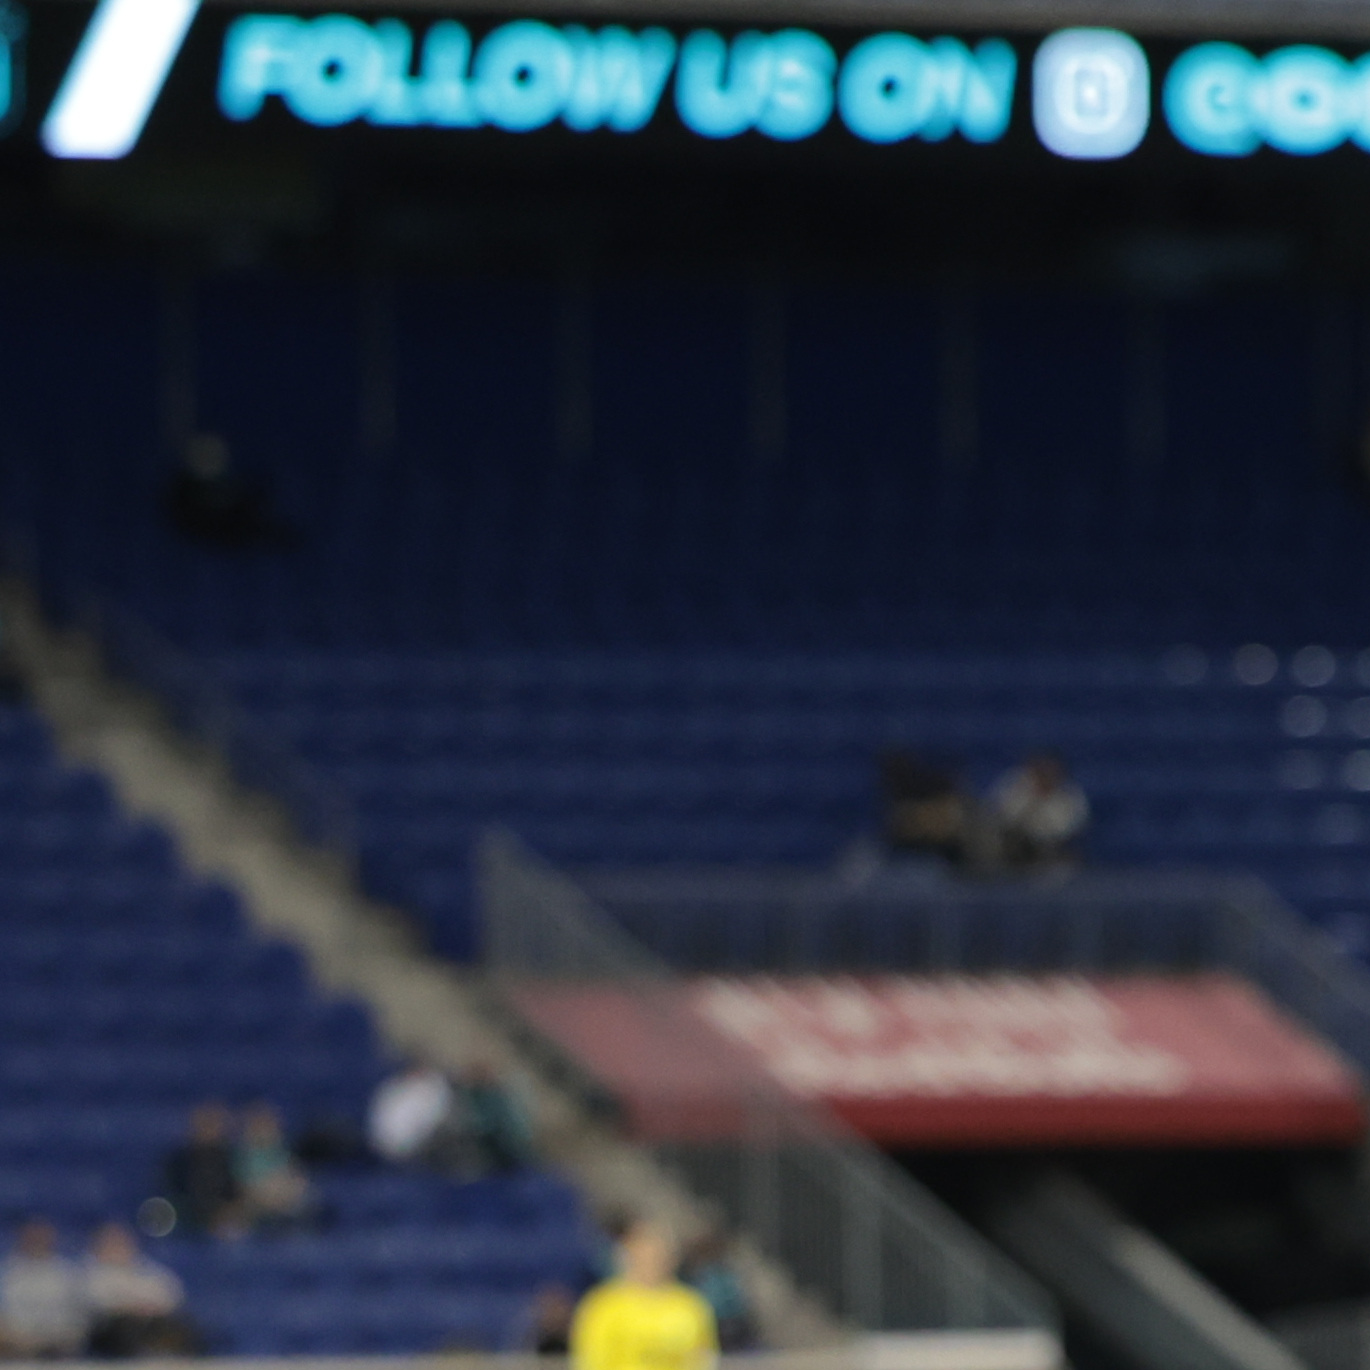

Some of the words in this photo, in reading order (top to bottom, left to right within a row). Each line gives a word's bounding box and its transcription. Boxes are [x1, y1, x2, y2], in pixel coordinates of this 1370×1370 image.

[217, 14, 675, 133] FOLLOW
[676, 28, 838, 140] US
[838, 32, 1017, 143] ON
